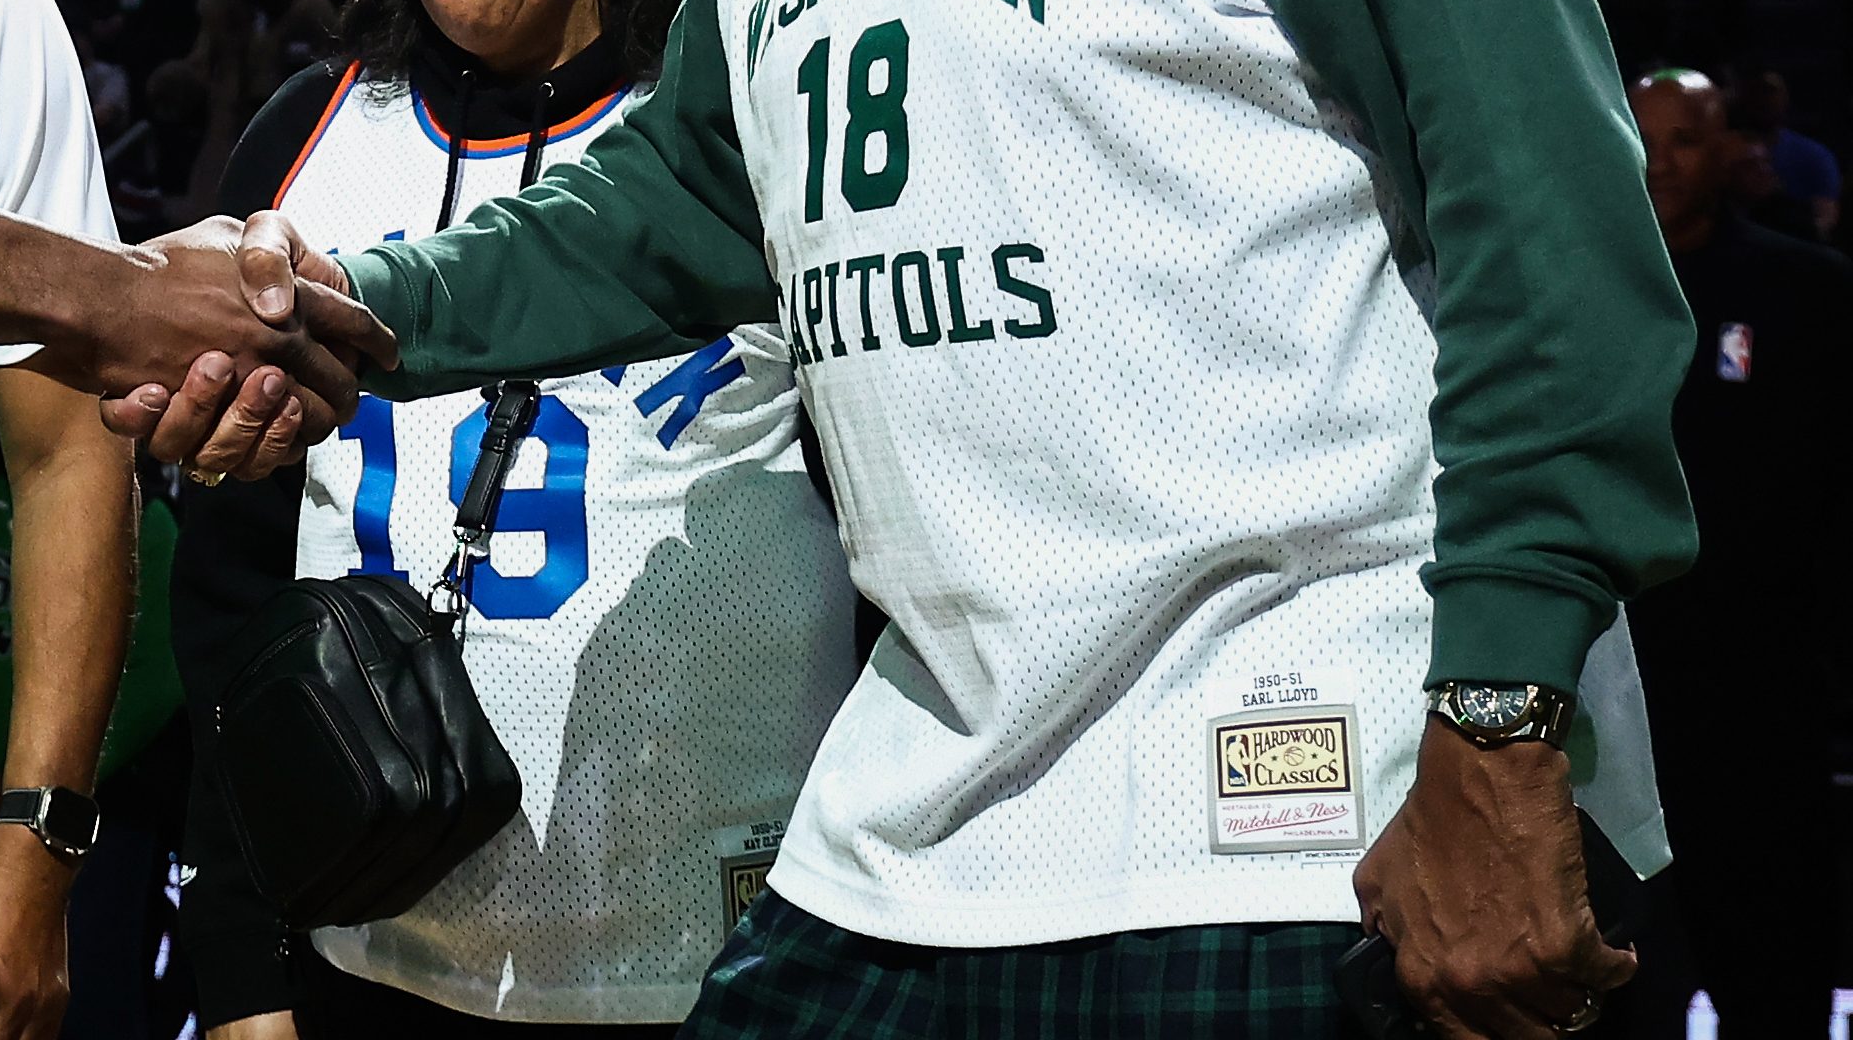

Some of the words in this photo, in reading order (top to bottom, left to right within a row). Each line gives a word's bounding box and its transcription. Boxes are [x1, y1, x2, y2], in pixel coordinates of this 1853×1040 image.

[797, 18, 910, 224] 18
[777, 243, 1058, 366] APITOLS
[338, 391, 589, 620] 19
[1253, 672, 1303, 689] 1950-51
[1242, 692, 1274, 707] EARL
[1278, 688, 1318, 703] LLOYD
[1252, 728, 1336, 760] HARDWOOD
[1254, 759, 1339, 786] CLASSICS
[1223, 809, 1291, 832] Mitchell
[1307, 802, 1349, 818] Ness
